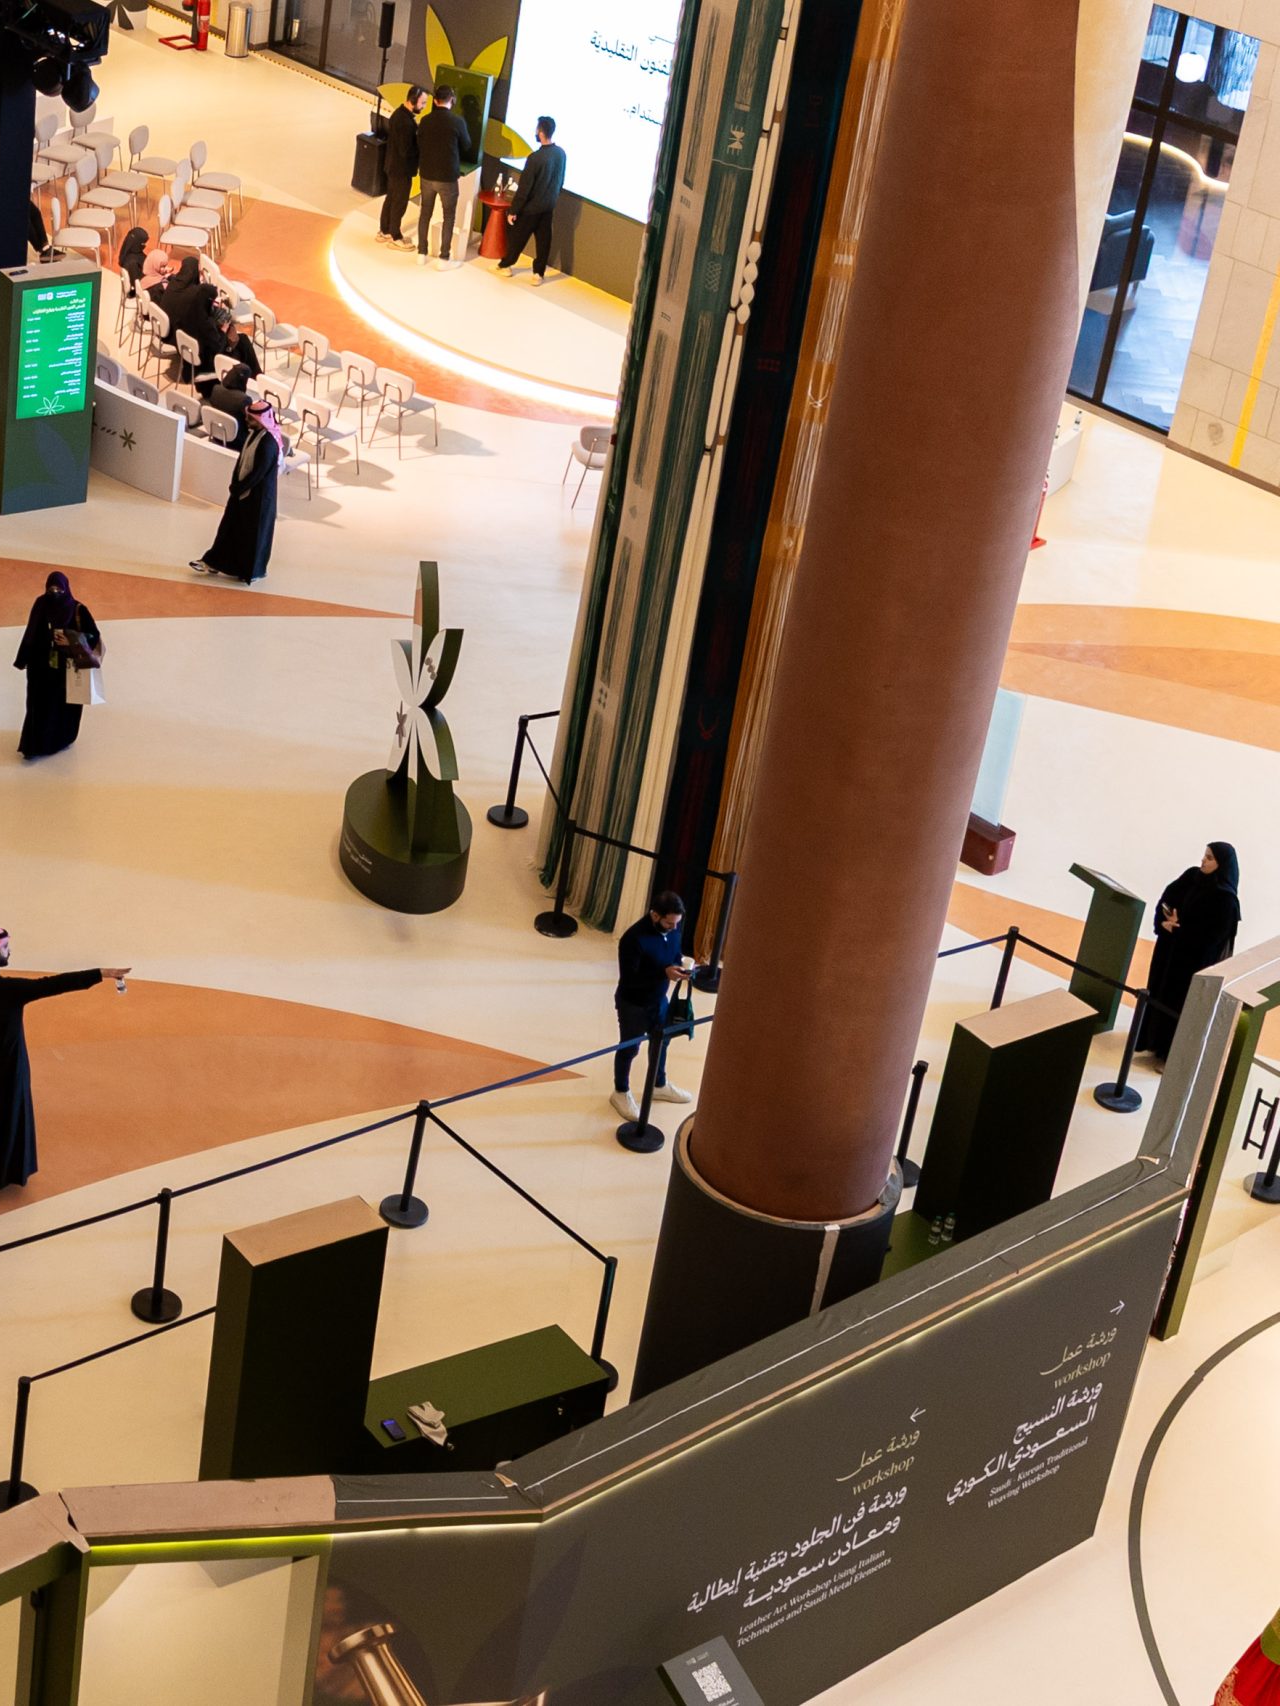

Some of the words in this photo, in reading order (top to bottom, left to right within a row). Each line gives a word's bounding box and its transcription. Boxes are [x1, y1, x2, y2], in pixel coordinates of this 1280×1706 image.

[1040, 1345, 1082, 1376] عمل
[1086, 1327, 1117, 1349] ورشة
[1054, 1352, 1111, 1389] workshop
[1066, 1382, 1103, 1408] ورشة
[887, 1430, 920, 1453] ورشة
[1007, 1403, 1097, 1473] السعودي
[1013, 1394, 1066, 1445] النسيج
[835, 1449, 883, 1482] عمل
[852, 1455, 915, 1496] workshop
[946, 1452, 1008, 1506] الكوري
[987, 1487, 1020, 1509] Weaving
[1021, 1464, 1060, 1490] Workshop
[989, 1478, 1011, 1497] Saudi
[1017, 1462, 1044, 1482] Korean
[1046, 1436, 1088, 1466] Traditional
[842, 1502, 865, 1534] فن
[868, 1486, 908, 1514] ورشة
[791, 1513, 842, 1558] الجلود
[828, 1515, 901, 1566] ومعادن
[743, 1557, 825, 1609] سعودية
[744, 1550, 788, 1582] بتقنية
[687, 1568, 742, 1614] إيطالية
[736, 1616, 785, 1648] Techniques
[786, 1606, 802, 1620] and
[803, 1594, 828, 1610] Saudi
[828, 1579, 852, 1598] Metal
[853, 1557, 892, 1583] Elements
[739, 1610, 772, 1635] Leather
[772, 1602, 788, 1617] Art
[789, 1578, 832, 1606] Workshop
[833, 1564, 857, 1584] Using
[858, 1550, 885, 1569] Italian
